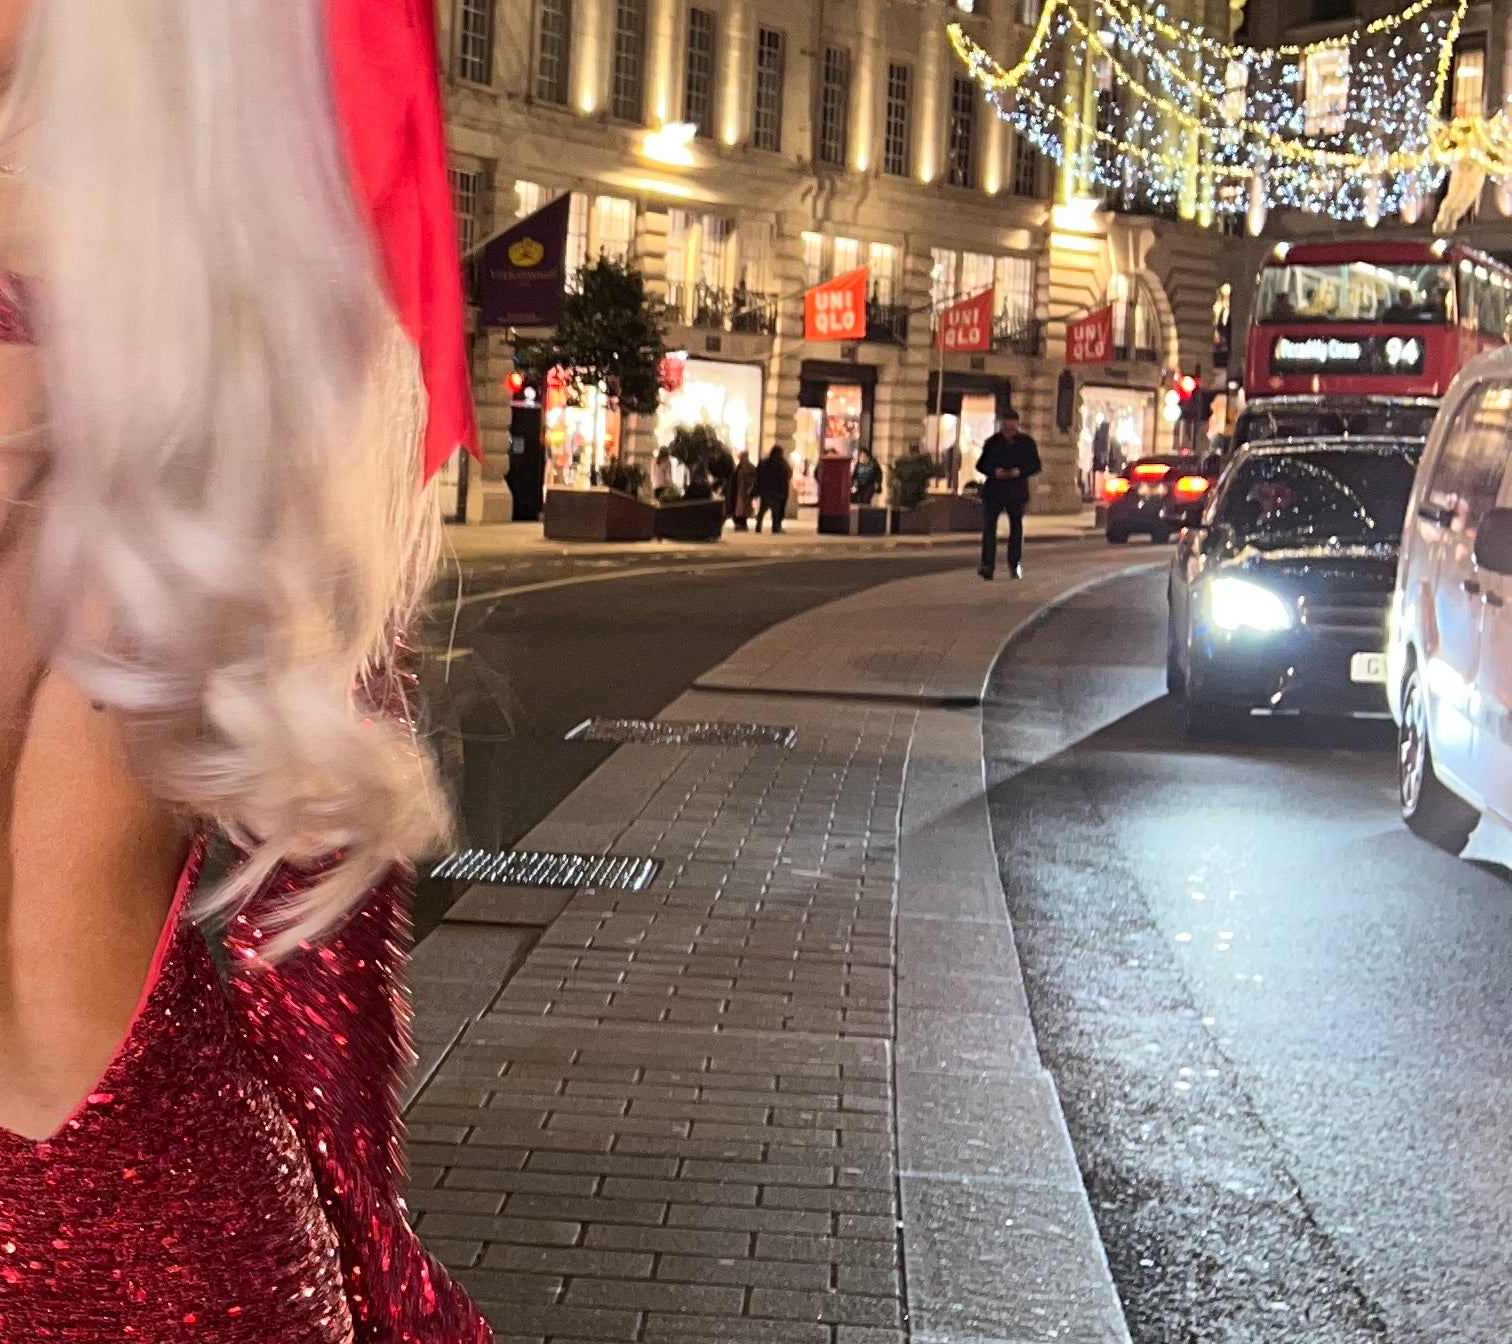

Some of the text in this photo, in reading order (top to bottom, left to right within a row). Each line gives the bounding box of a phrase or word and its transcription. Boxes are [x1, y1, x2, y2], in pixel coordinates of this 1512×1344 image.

[815, 290, 852, 310] UNI
[815, 311, 855, 334] QLO
[949, 307, 979, 325] UNI
[945, 327, 980, 348] QLO
[1073, 323, 1102, 342] UNI
[1073, 341, 1104, 360] QLO
[1385, 336, 1419, 366] 94
